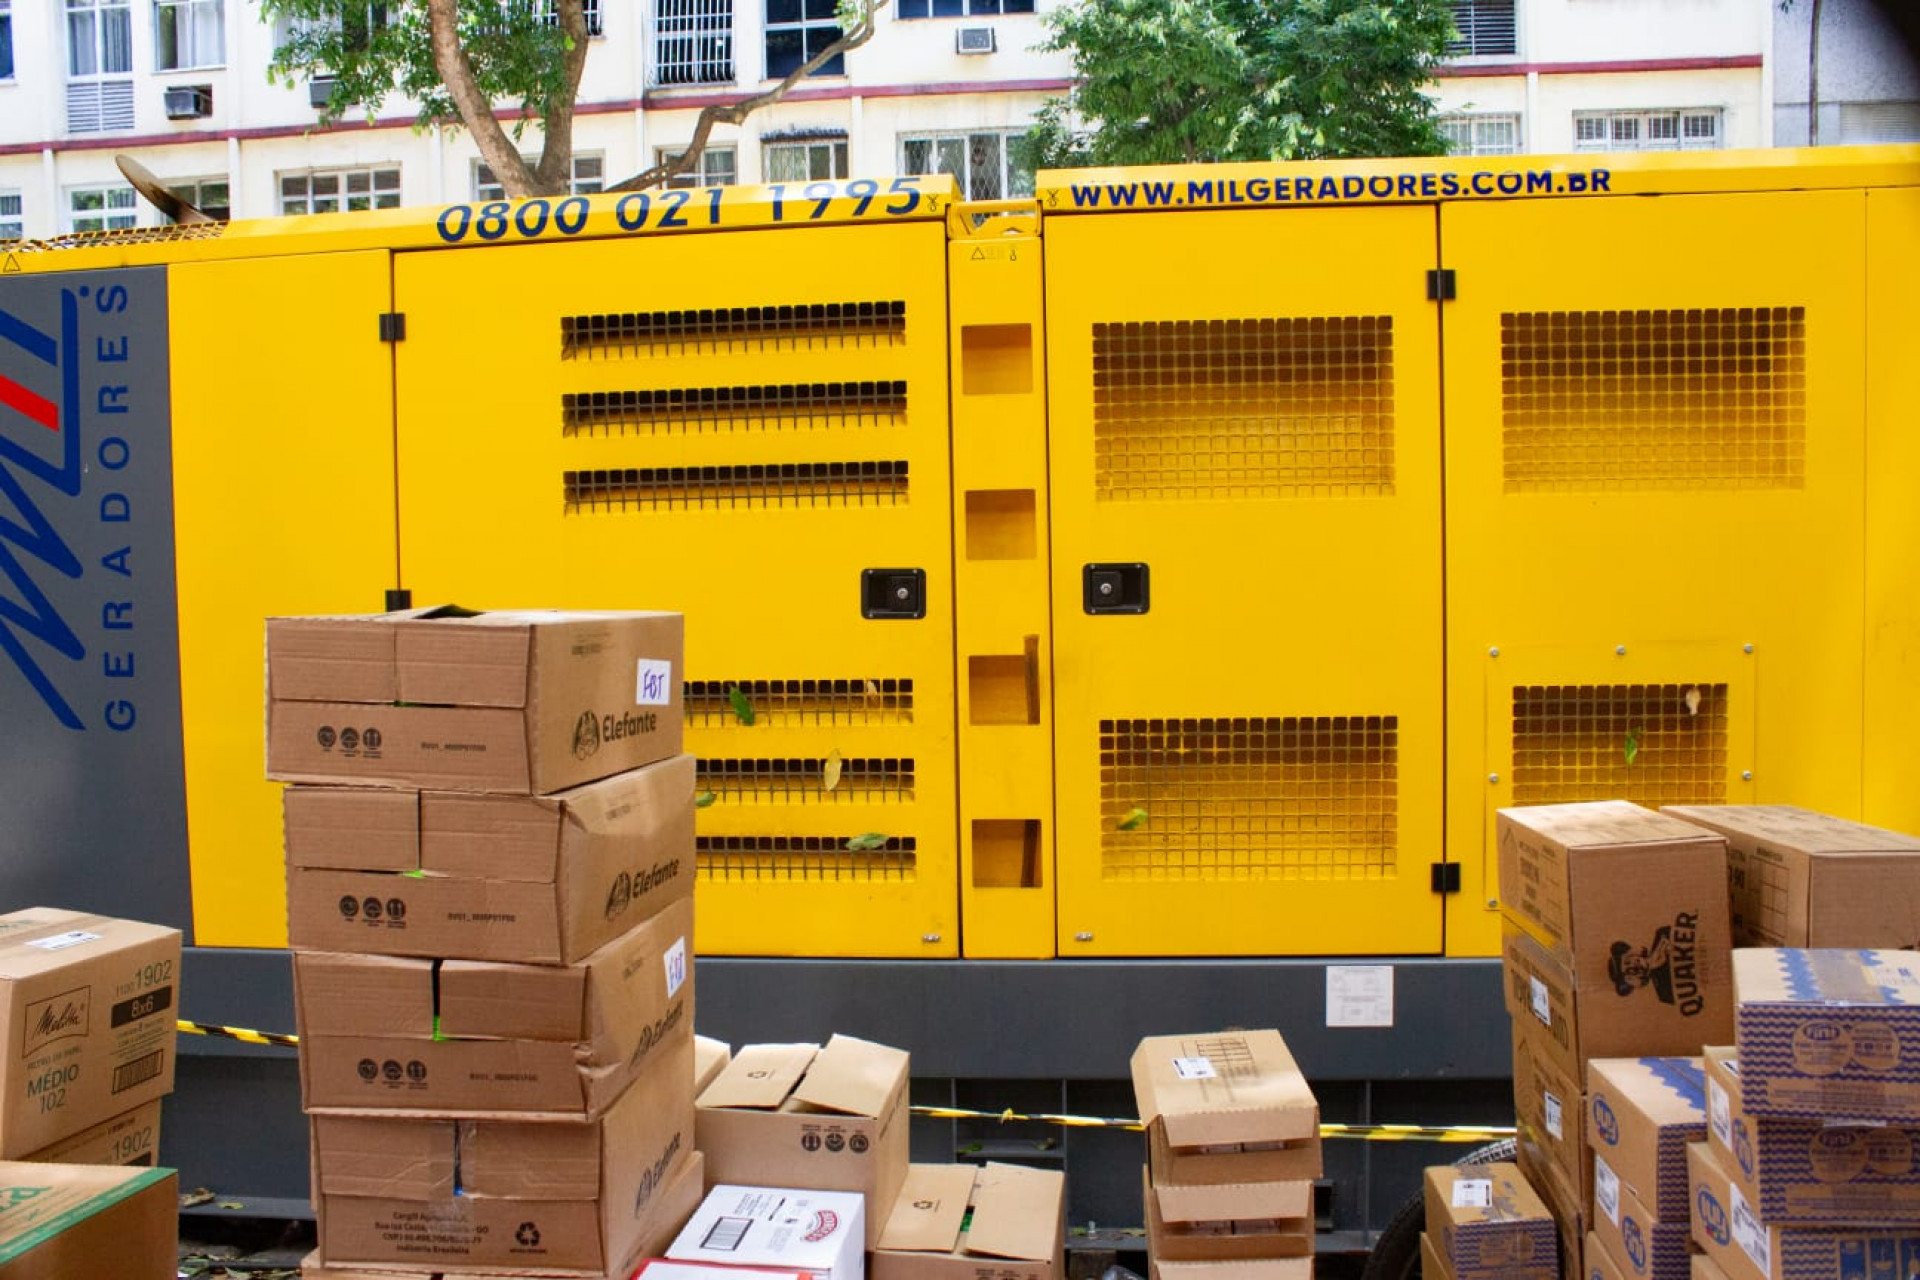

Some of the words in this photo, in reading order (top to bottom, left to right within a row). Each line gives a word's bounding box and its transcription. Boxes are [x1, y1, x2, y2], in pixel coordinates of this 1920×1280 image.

[1070, 169, 1611, 208] WWW.MILGERADORES.COM.BR
[436, 196, 590, 243] 0800
[615, 189, 723, 231] 021
[769, 177, 921, 222] 1995
[97, 284, 136, 732] GERADORES
[602, 711, 657, 742] Elefante
[632, 858, 680, 899] Elefante
[134, 959, 172, 989] 1902
[1674, 911, 1704, 1017] QUAKER
[27, 1063, 79, 1099] MÉDIO
[41, 1088, 66, 1114] 102
[113, 1126, 152, 1161] 1902
